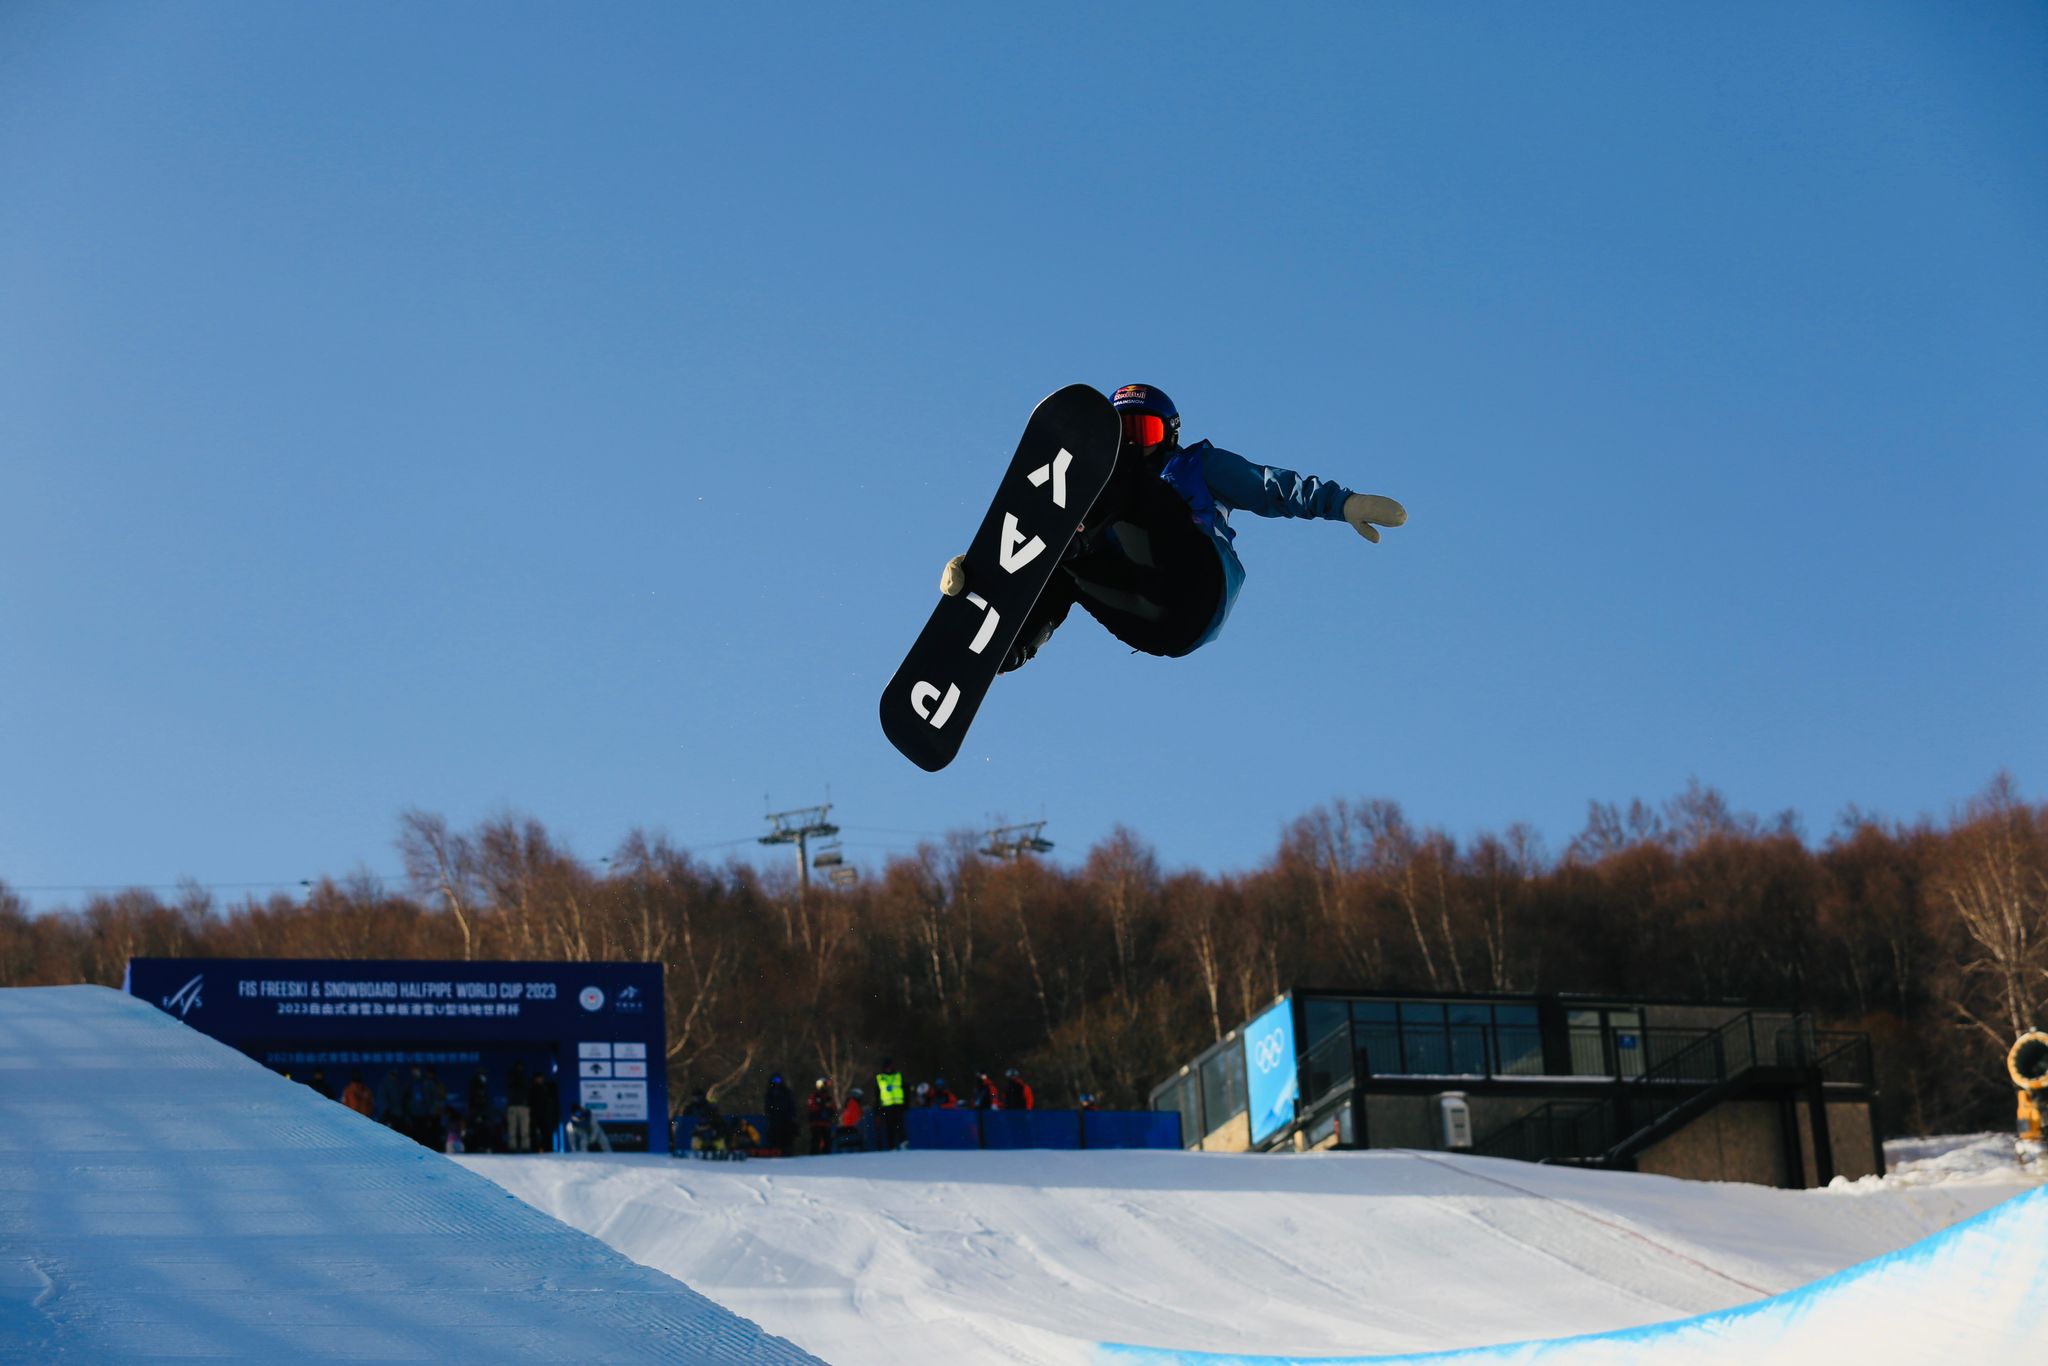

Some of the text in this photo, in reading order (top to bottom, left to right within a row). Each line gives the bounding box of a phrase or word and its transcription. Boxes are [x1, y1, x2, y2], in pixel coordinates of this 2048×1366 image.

[909, 447, 1074, 730] PLAY
[239, 980, 556, 999] FIS FREESKI & SNOWBOARD HALFPIPE WORLD CUP 2023
